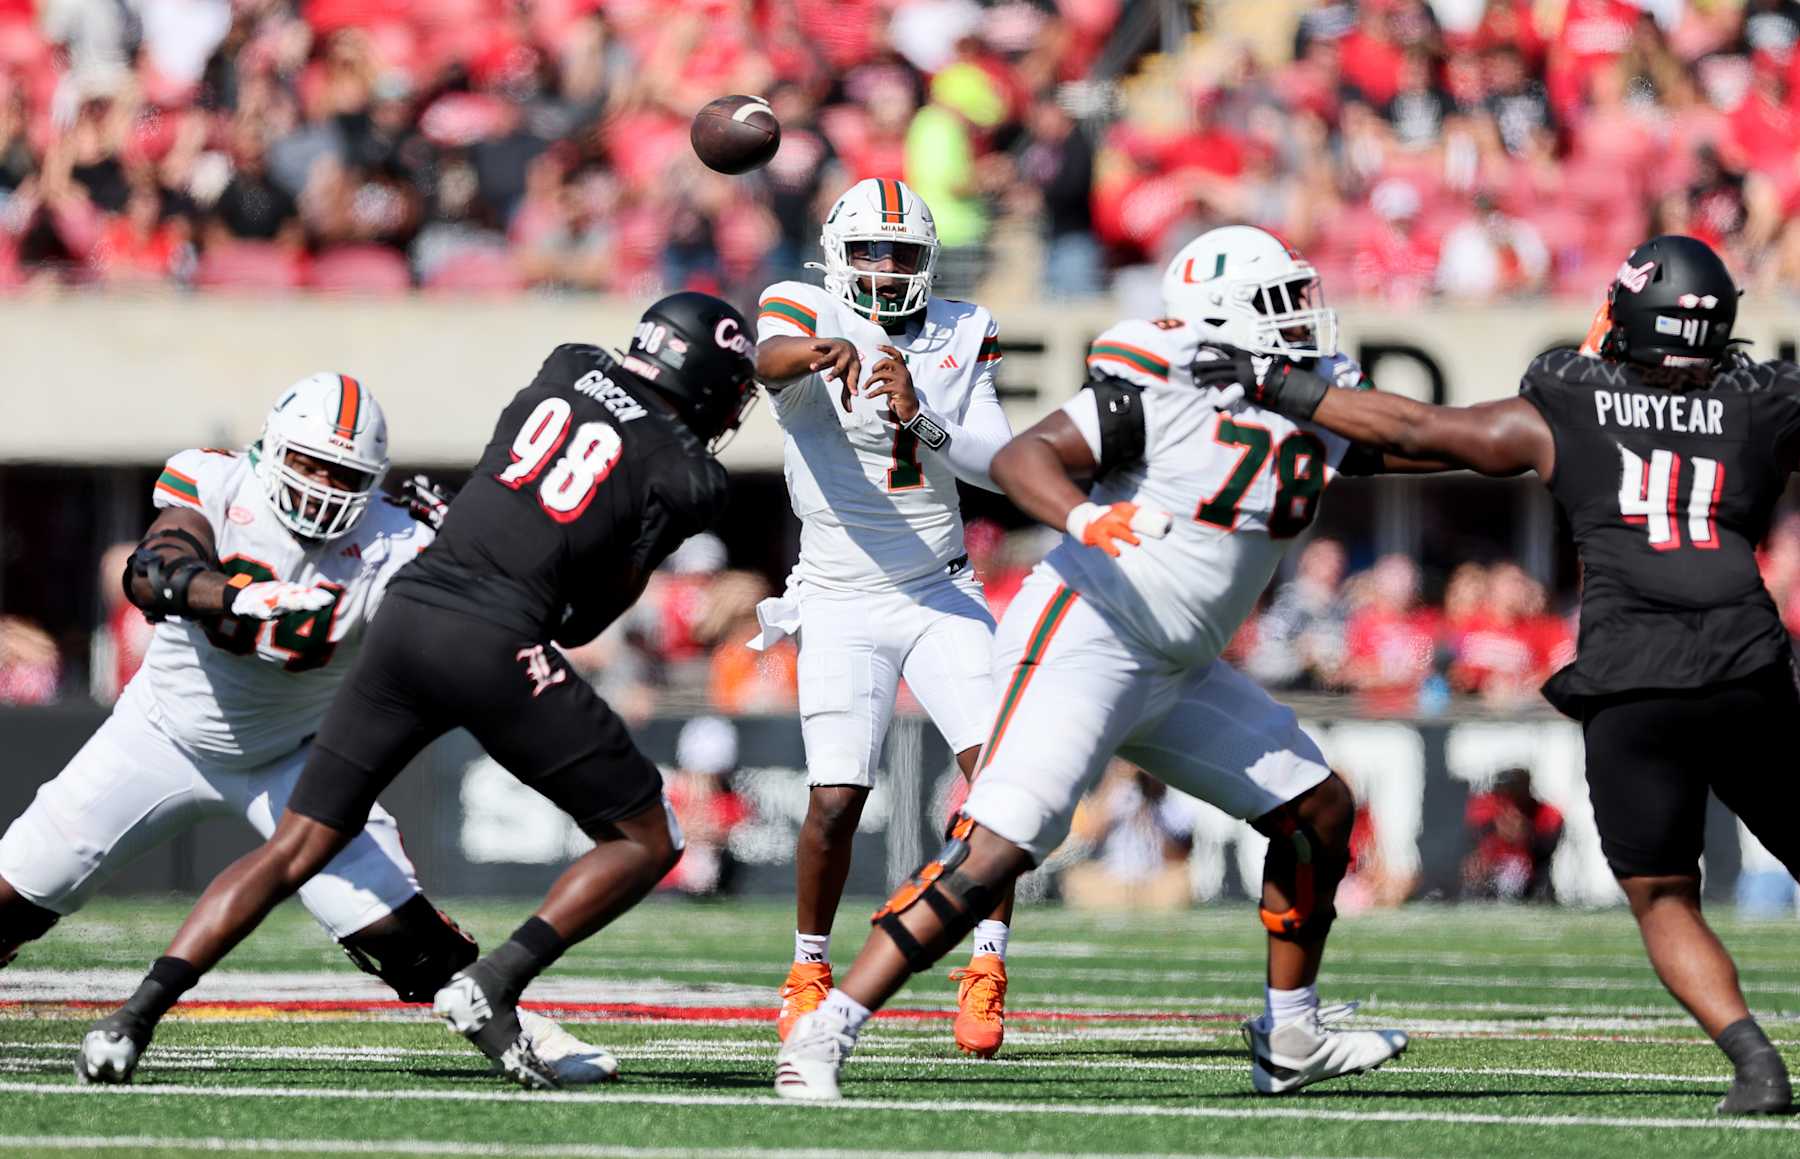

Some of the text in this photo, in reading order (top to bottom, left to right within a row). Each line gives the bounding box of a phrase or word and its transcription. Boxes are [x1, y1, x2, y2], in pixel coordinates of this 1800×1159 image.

[880, 225, 908, 233] MIAMI
[1682, 317, 1709, 347] 41
[573, 369, 649, 423] GREEN
[1594, 389, 1724, 435] PURYEAR
[492, 396, 623, 525] 98
[1192, 410, 1330, 540] 78
[1614, 440, 1727, 552] 41
